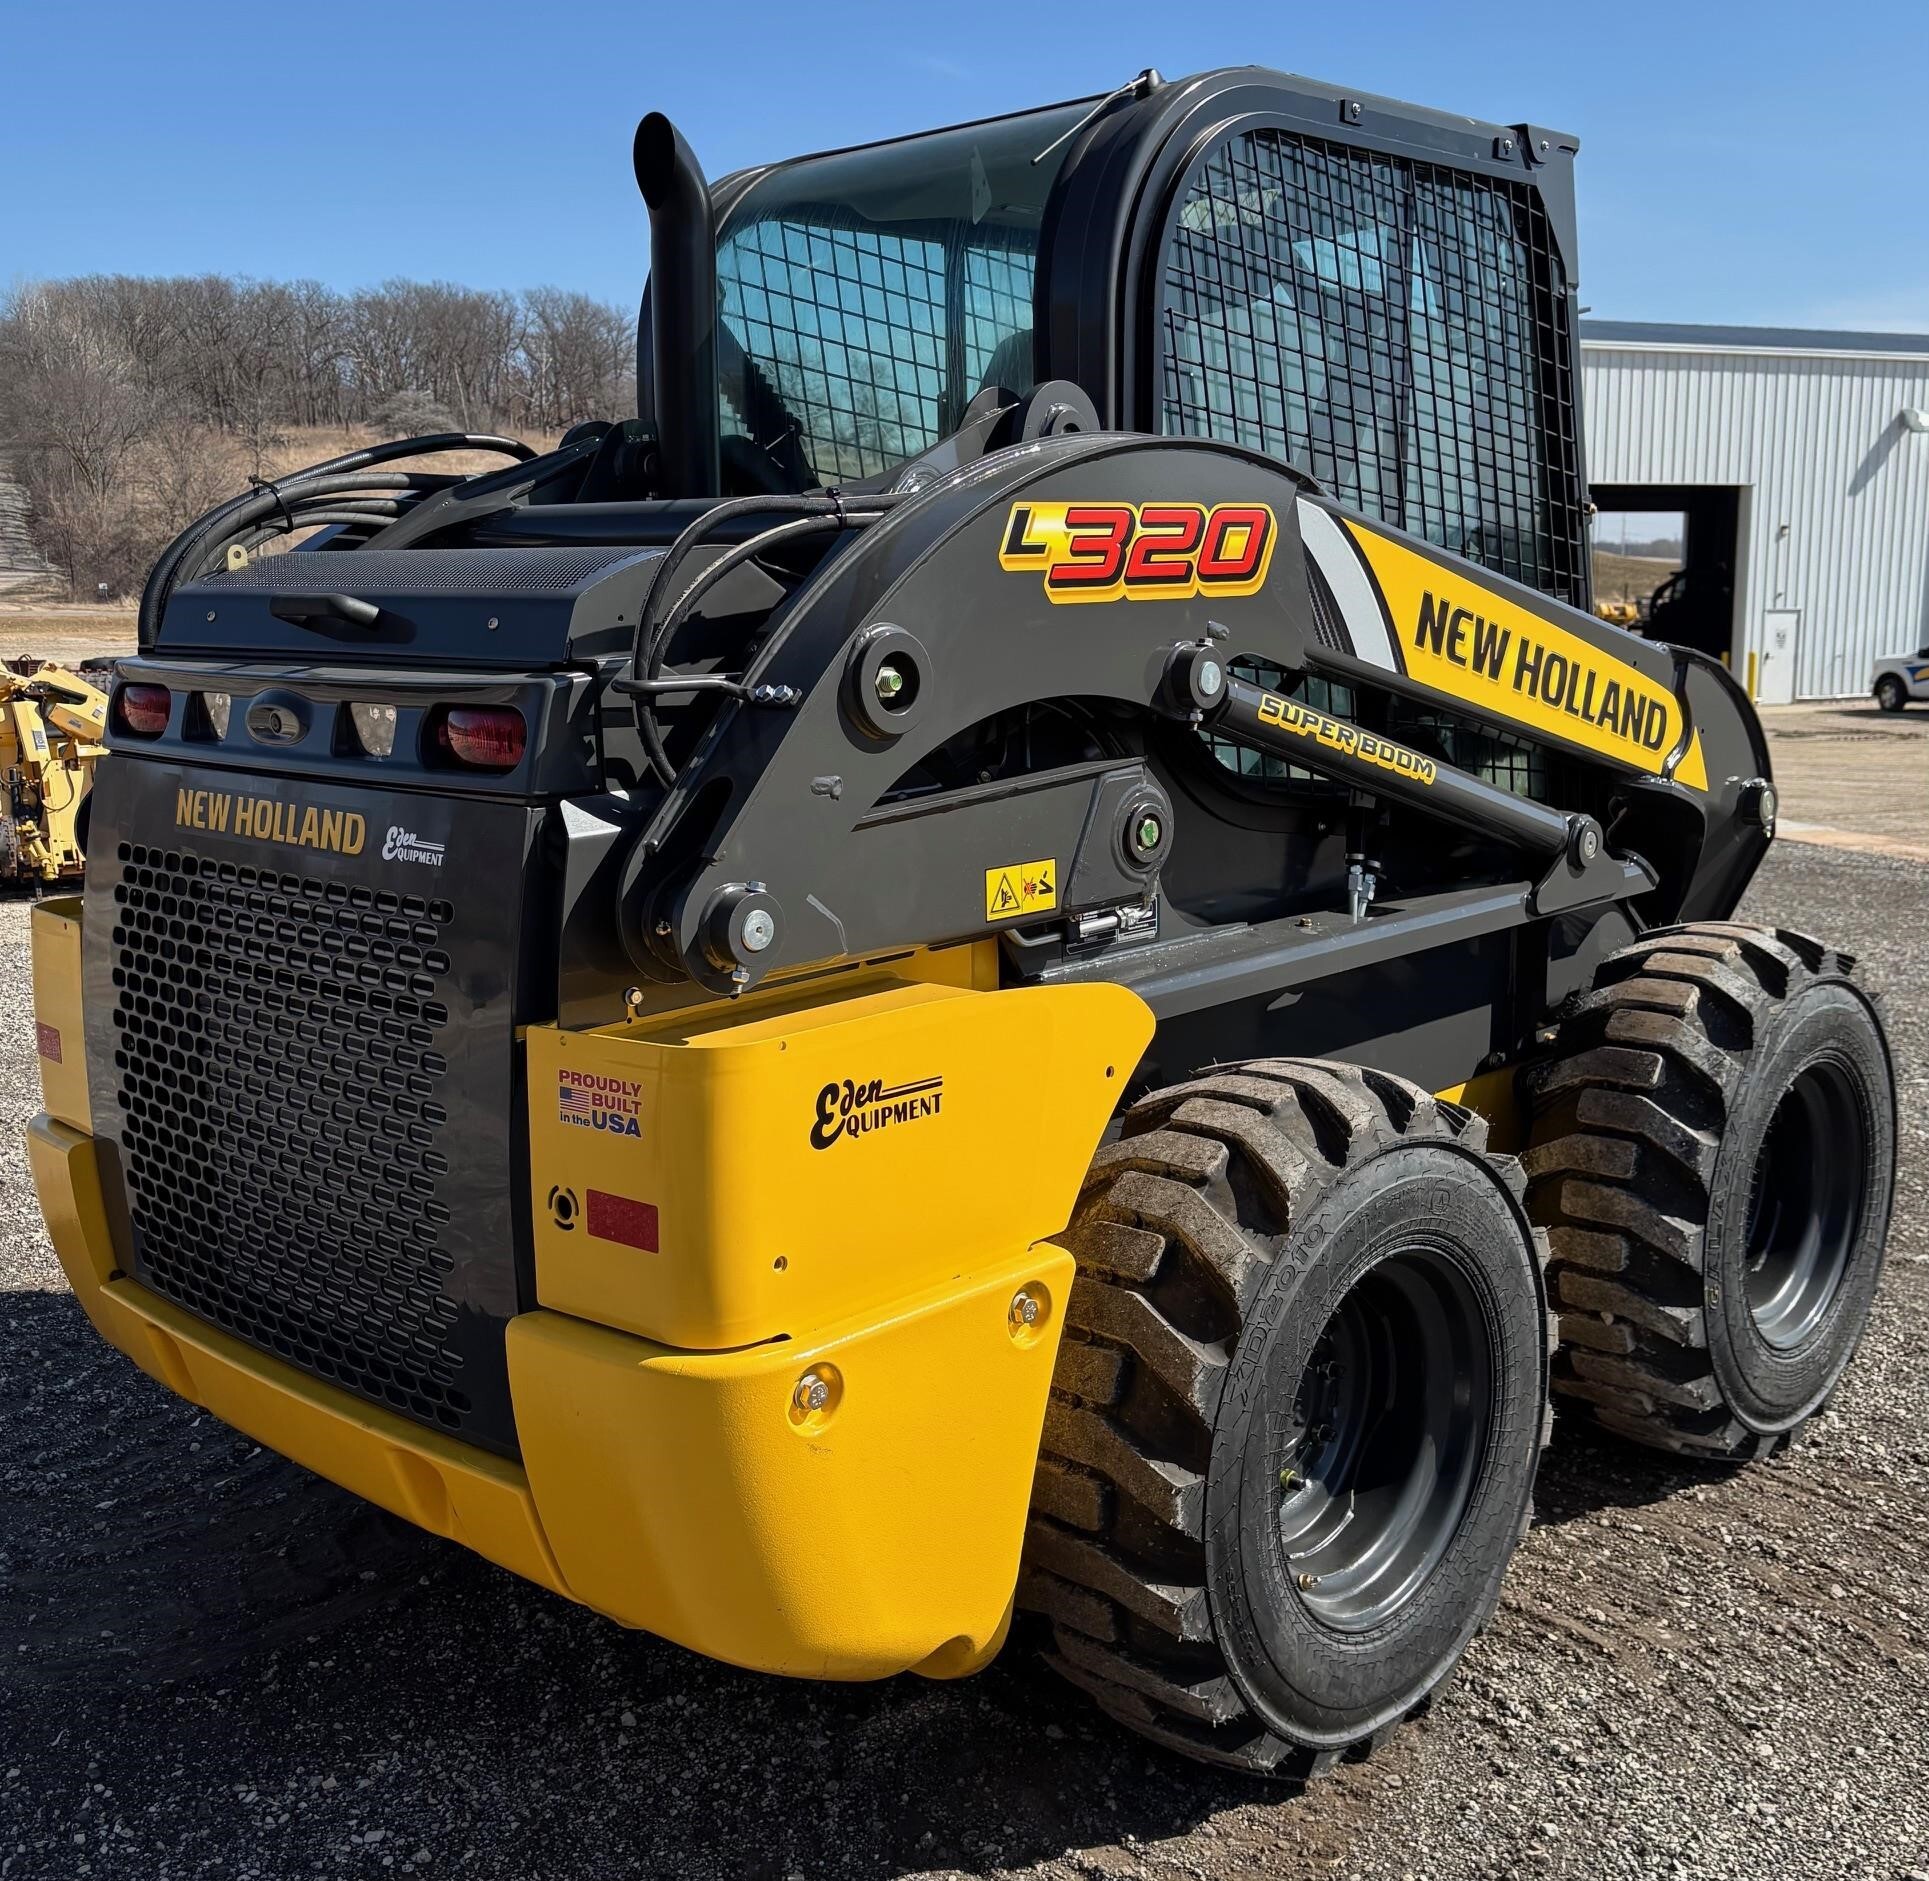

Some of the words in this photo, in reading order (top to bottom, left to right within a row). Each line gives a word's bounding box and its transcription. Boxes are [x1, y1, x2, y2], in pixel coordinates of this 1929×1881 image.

[1000, 503, 1277, 602] L320
[1415, 590, 1511, 682] NEW
[1512, 637, 1668, 752] HOLLAND
[1258, 694, 1358, 755] SUPER
[1357, 733, 1437, 786] BOOM
[176, 788, 231, 832] NEW
[234, 796, 366, 855] HOLLAND
[559, 1069, 642, 1097] PROUDLY
[592, 1092, 642, 1115] BUILT
[810, 1079, 882, 1150] Eden
[560, 1111, 570, 1123] in
[572, 1114, 591, 1126] the
[592, 1109, 642, 1138] USA
[1238, 1223, 1324, 1407] XD2010
